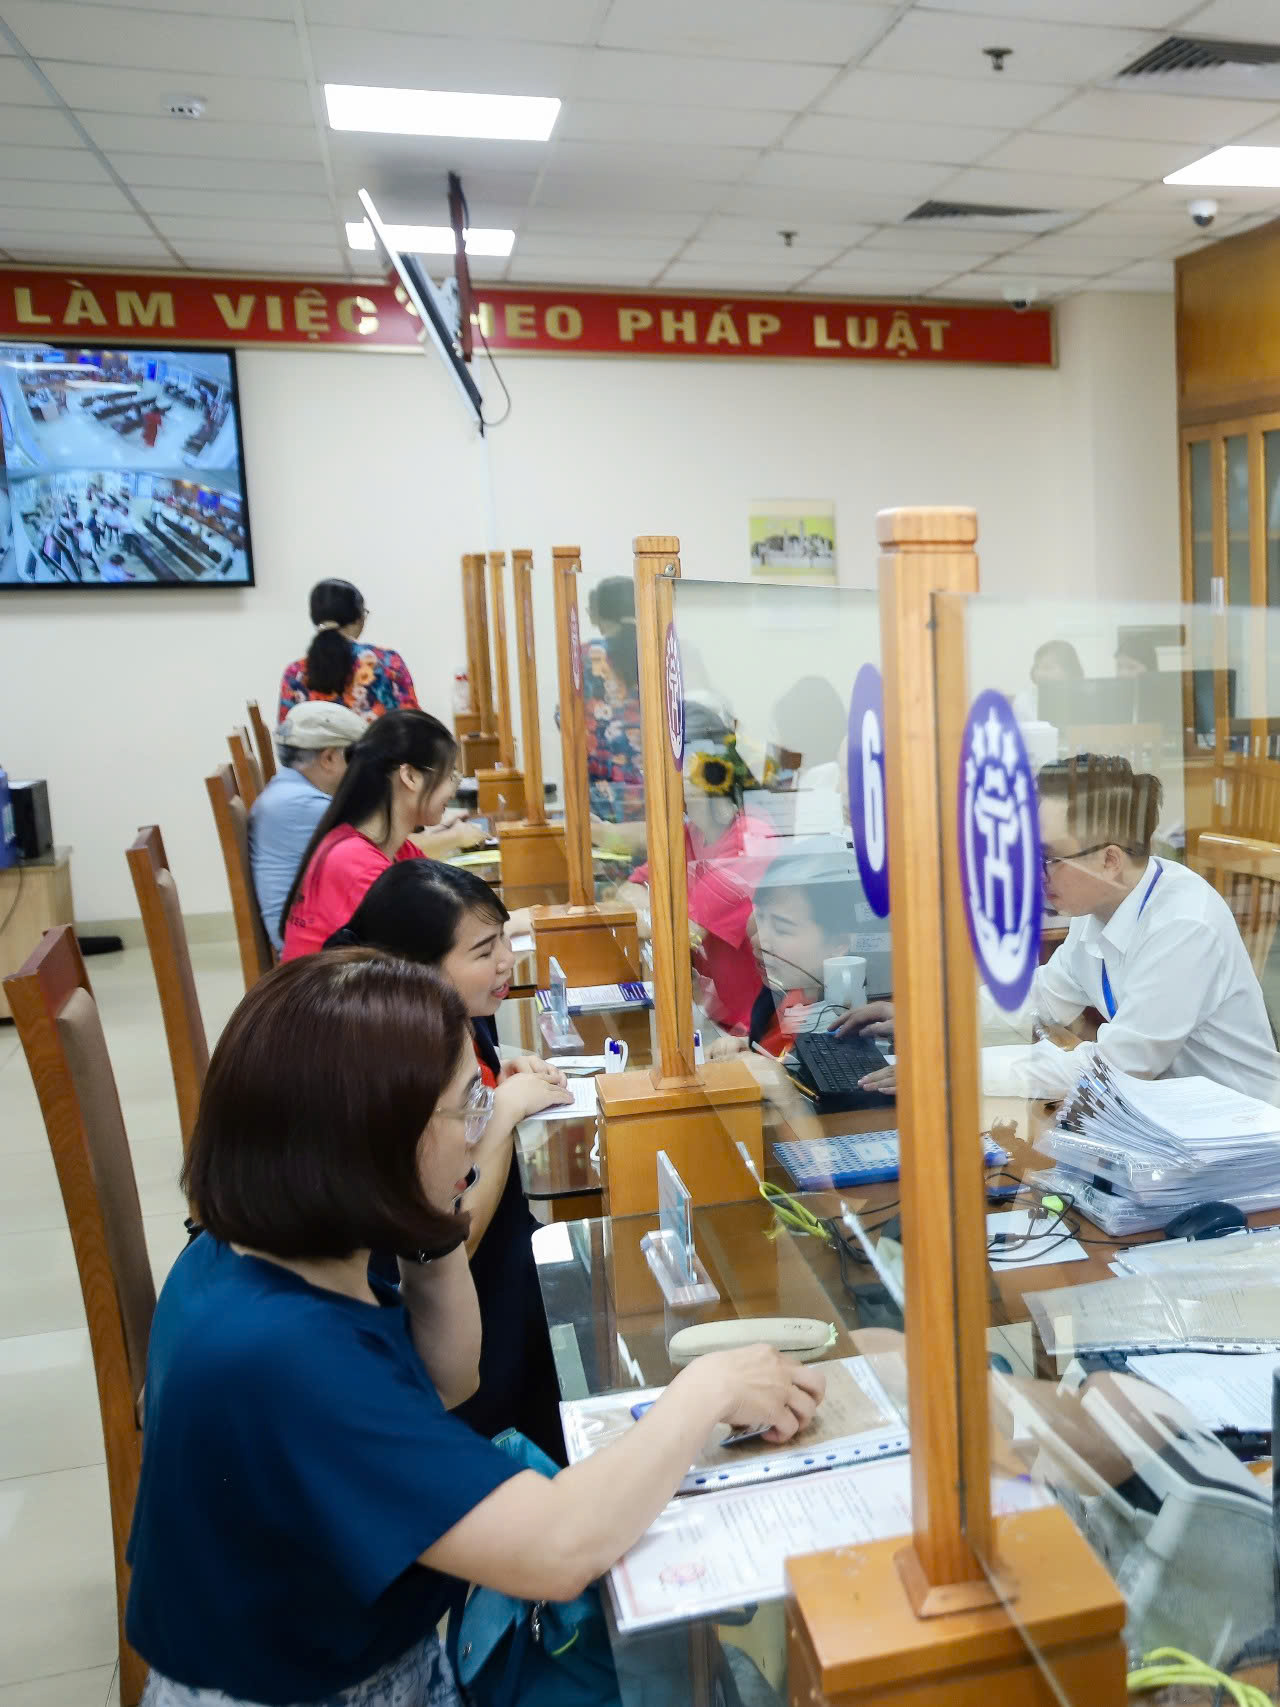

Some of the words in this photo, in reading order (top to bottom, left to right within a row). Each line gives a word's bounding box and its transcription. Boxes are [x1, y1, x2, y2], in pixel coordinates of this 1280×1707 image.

[14, 279, 177, 329] LÀM
[213, 287, 380, 341] VIỆC
[617, 303, 781, 346] PHÁP
[813, 309, 951, 357] LUẬT
